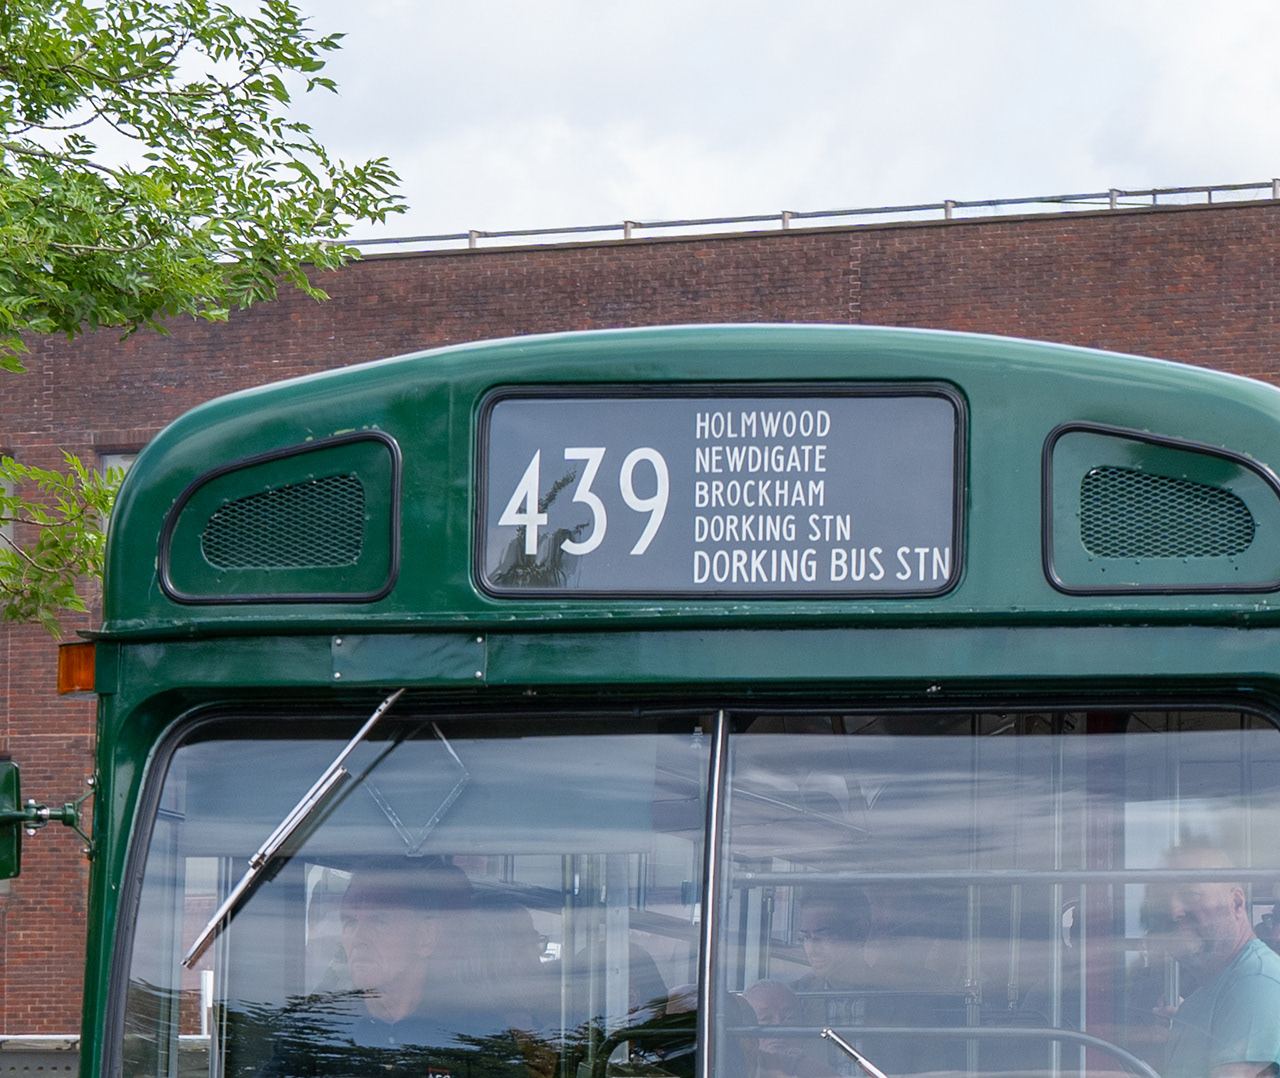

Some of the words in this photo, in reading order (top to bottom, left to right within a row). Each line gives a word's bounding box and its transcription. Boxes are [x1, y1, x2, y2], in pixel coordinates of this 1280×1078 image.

[696, 410, 831, 439] HOLMWOOD
[695, 445, 827, 473] NEWDIGATE
[497, 447, 669, 555] 439
[695, 480, 825, 508] BROCKHAM
[694, 514, 796, 542] DORKING
[808, 514, 851, 541] STN
[693, 550, 817, 584] DORKING
[830, 548, 885, 582] BUS
[896, 547, 950, 580] STN
